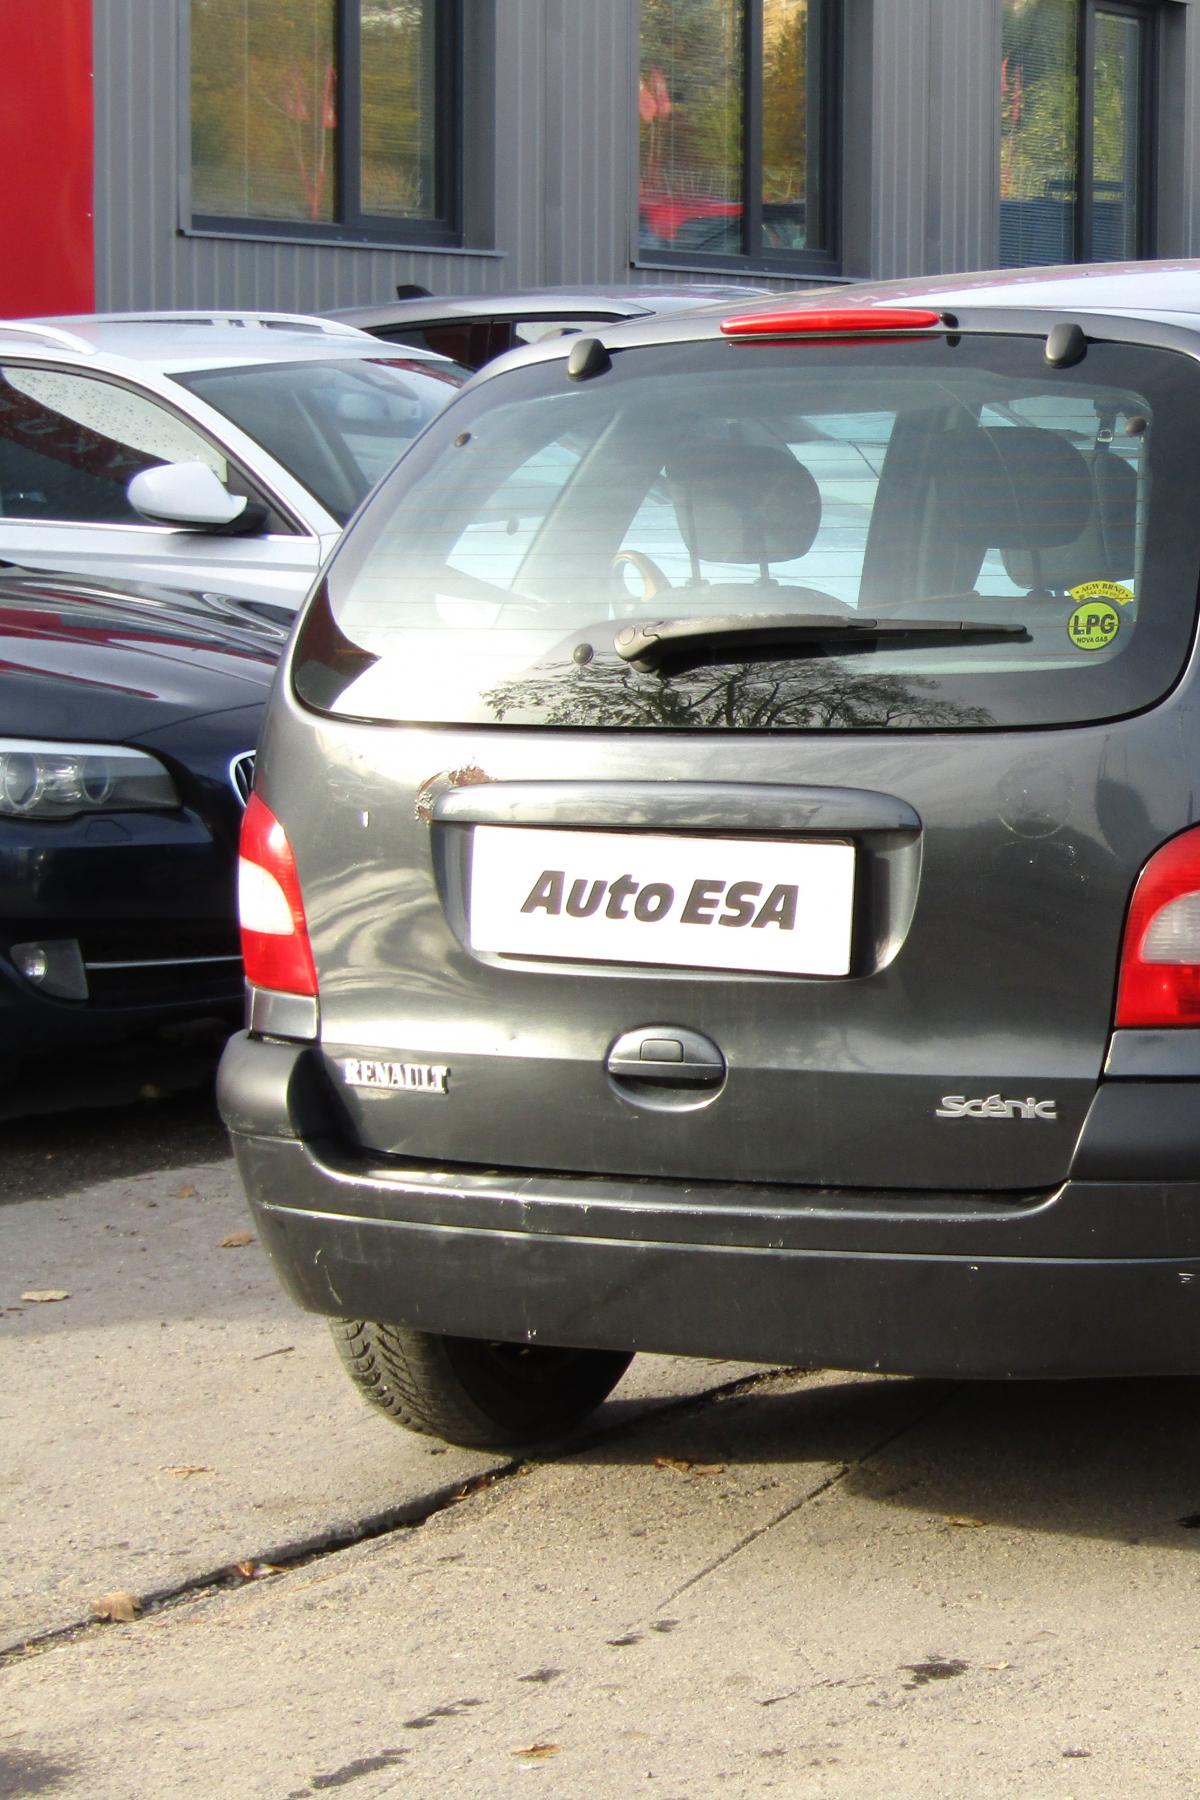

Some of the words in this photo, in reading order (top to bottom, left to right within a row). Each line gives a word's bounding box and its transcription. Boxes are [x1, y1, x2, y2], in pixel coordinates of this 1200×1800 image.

[1073, 614, 1115, 635] LPG
[520, 870, 675, 923] Auto
[680, 879, 799, 930] ESA
[345, 1058, 450, 1095] RENAULT
[936, 1093, 1057, 1119] Scénic
